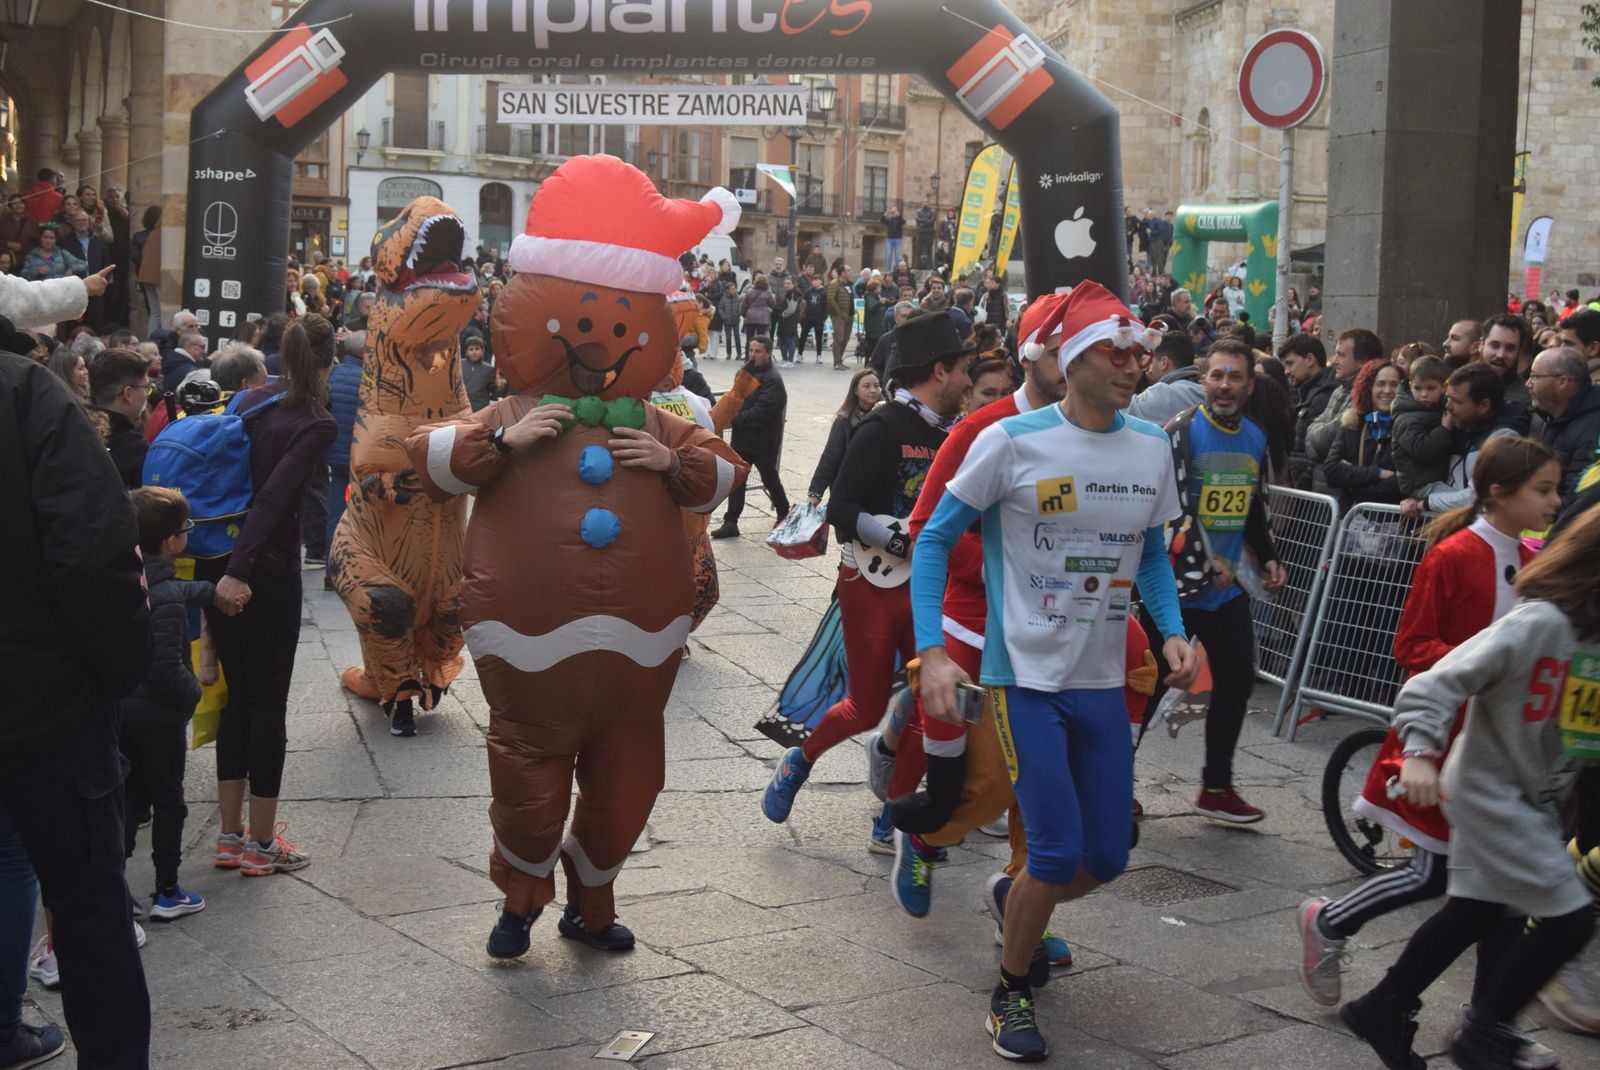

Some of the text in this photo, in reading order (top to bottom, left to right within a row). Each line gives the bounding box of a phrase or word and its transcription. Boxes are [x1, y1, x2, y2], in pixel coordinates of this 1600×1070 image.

[528, 54, 580, 68] oral
[590, 57, 605, 68] e
[613, 54, 748, 70] implantes
[756, 54, 876, 68] dentales
[502, 92, 804, 116] SAN SILVESTRE ZAMORANA
[1055, 171, 1101, 184] invisalign
[202, 245, 237, 257] DSD
[1206, 490, 1246, 512] 623
